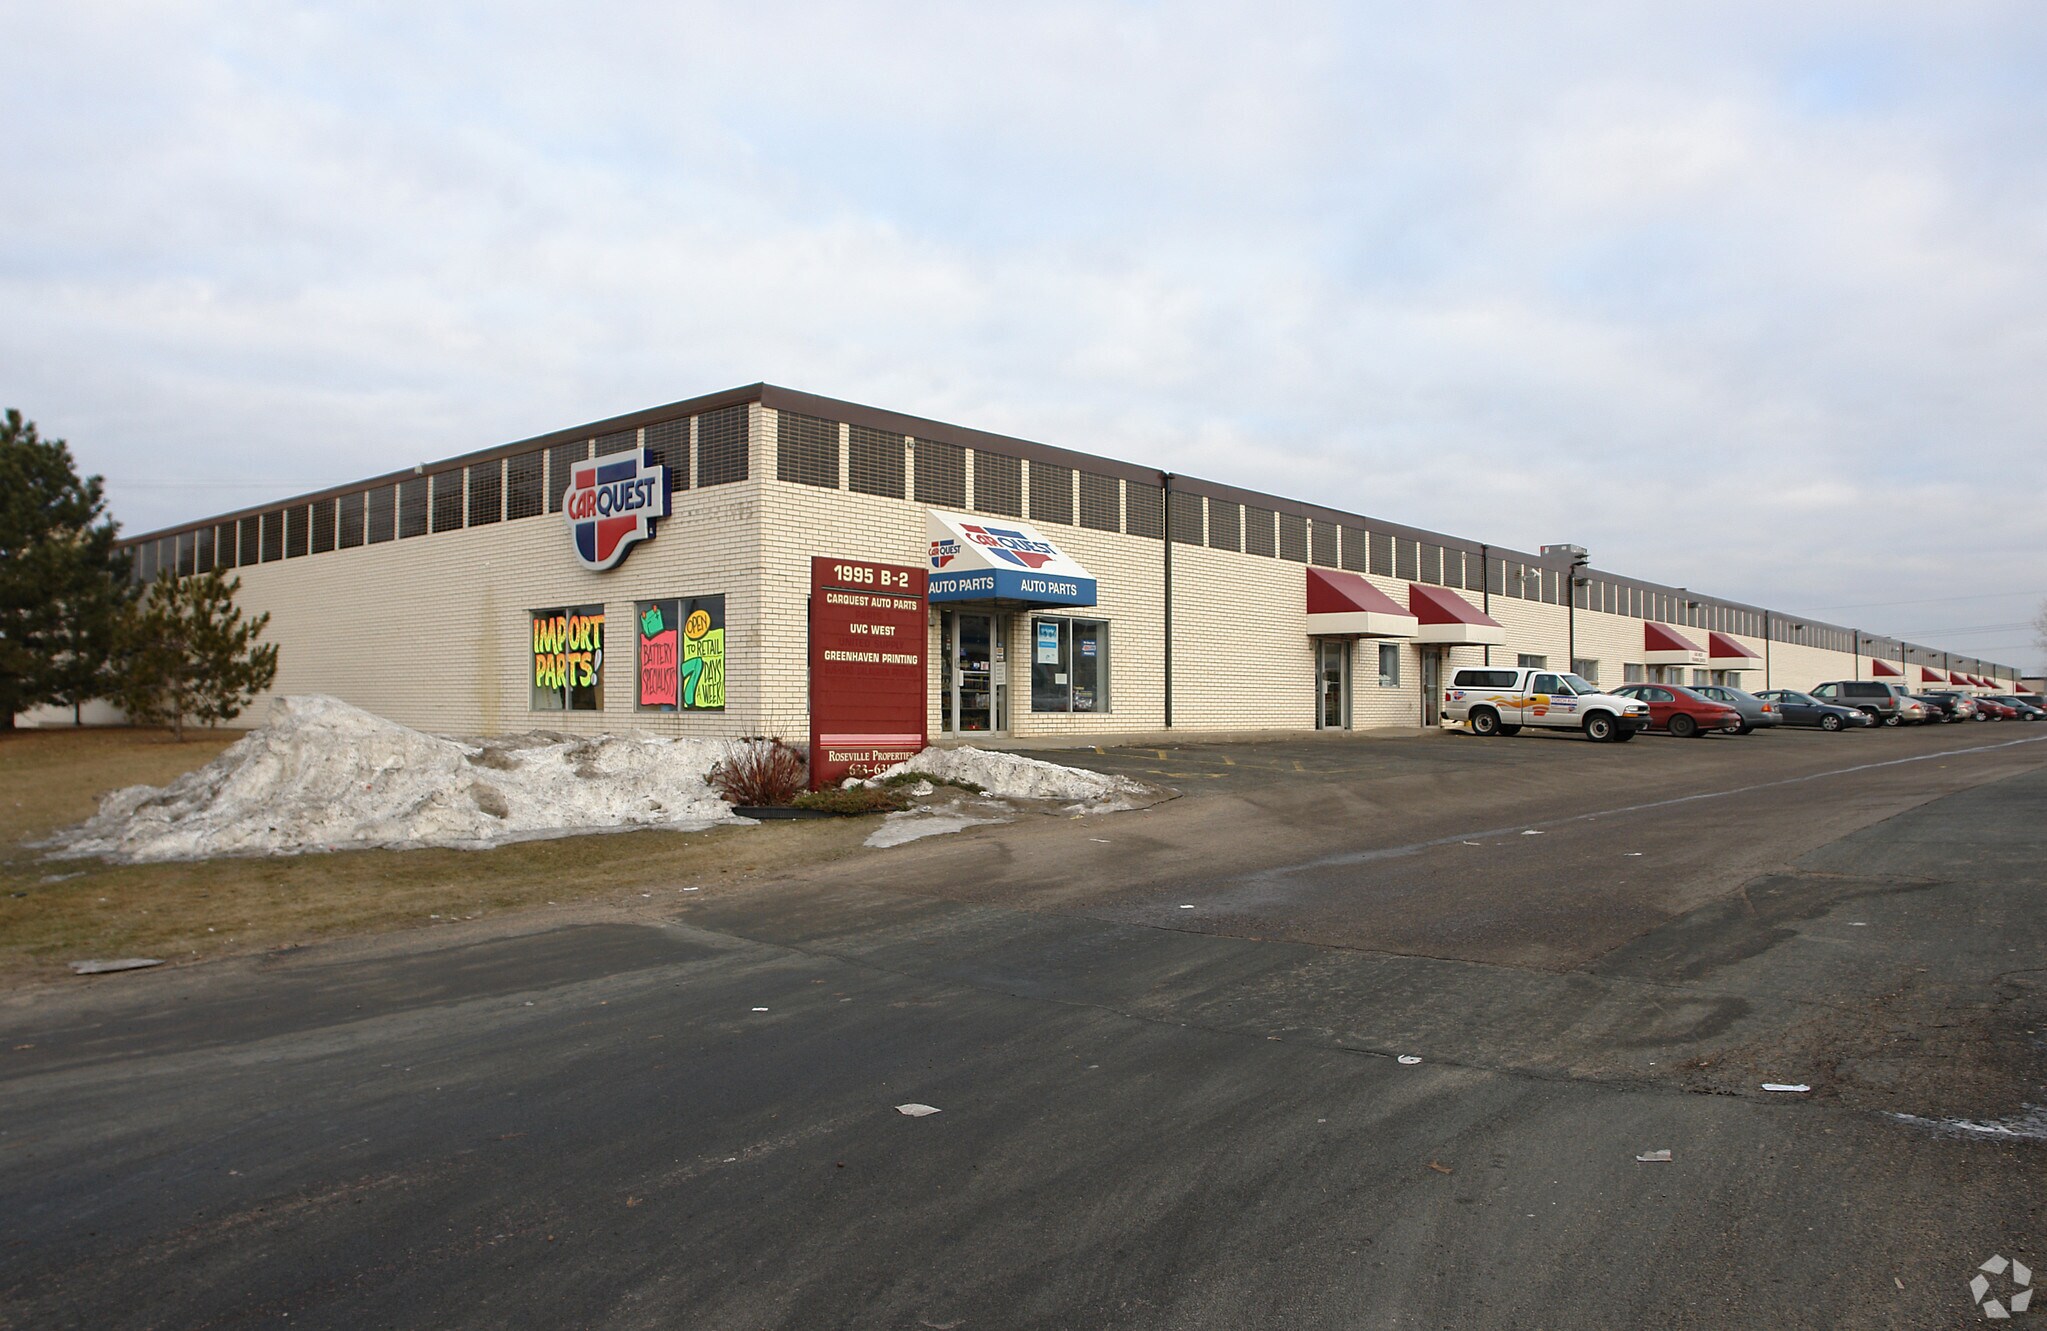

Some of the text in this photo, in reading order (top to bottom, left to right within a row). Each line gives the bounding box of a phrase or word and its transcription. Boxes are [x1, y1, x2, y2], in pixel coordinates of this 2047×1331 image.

[568, 477, 655, 519] CARQUEST
[928, 544, 961, 556] CARQUEST
[965, 532, 1057, 555] CARQUEST
[833, 564, 909, 588] 1995 B-2
[928, 576, 994, 594] AUTO PARTS
[1021, 579, 1077, 596] AUTO PARTS
[826, 593, 917, 611] CARQUEST AUTO PARTS
[533, 614, 605, 654] IMPORT
[686, 614, 708, 634] OPEN
[850, 623, 896, 636] UVC WEST
[643, 642, 674, 666] BATTERY
[686, 638, 722, 656] TO RETAIL
[824, 650, 918, 665] GREENHAVEN PRINTING
[535, 649, 602, 690] PARTS!
[642, 667, 675, 697] SPECIALISTS
[681, 656, 722, 705] 7 DAYS
